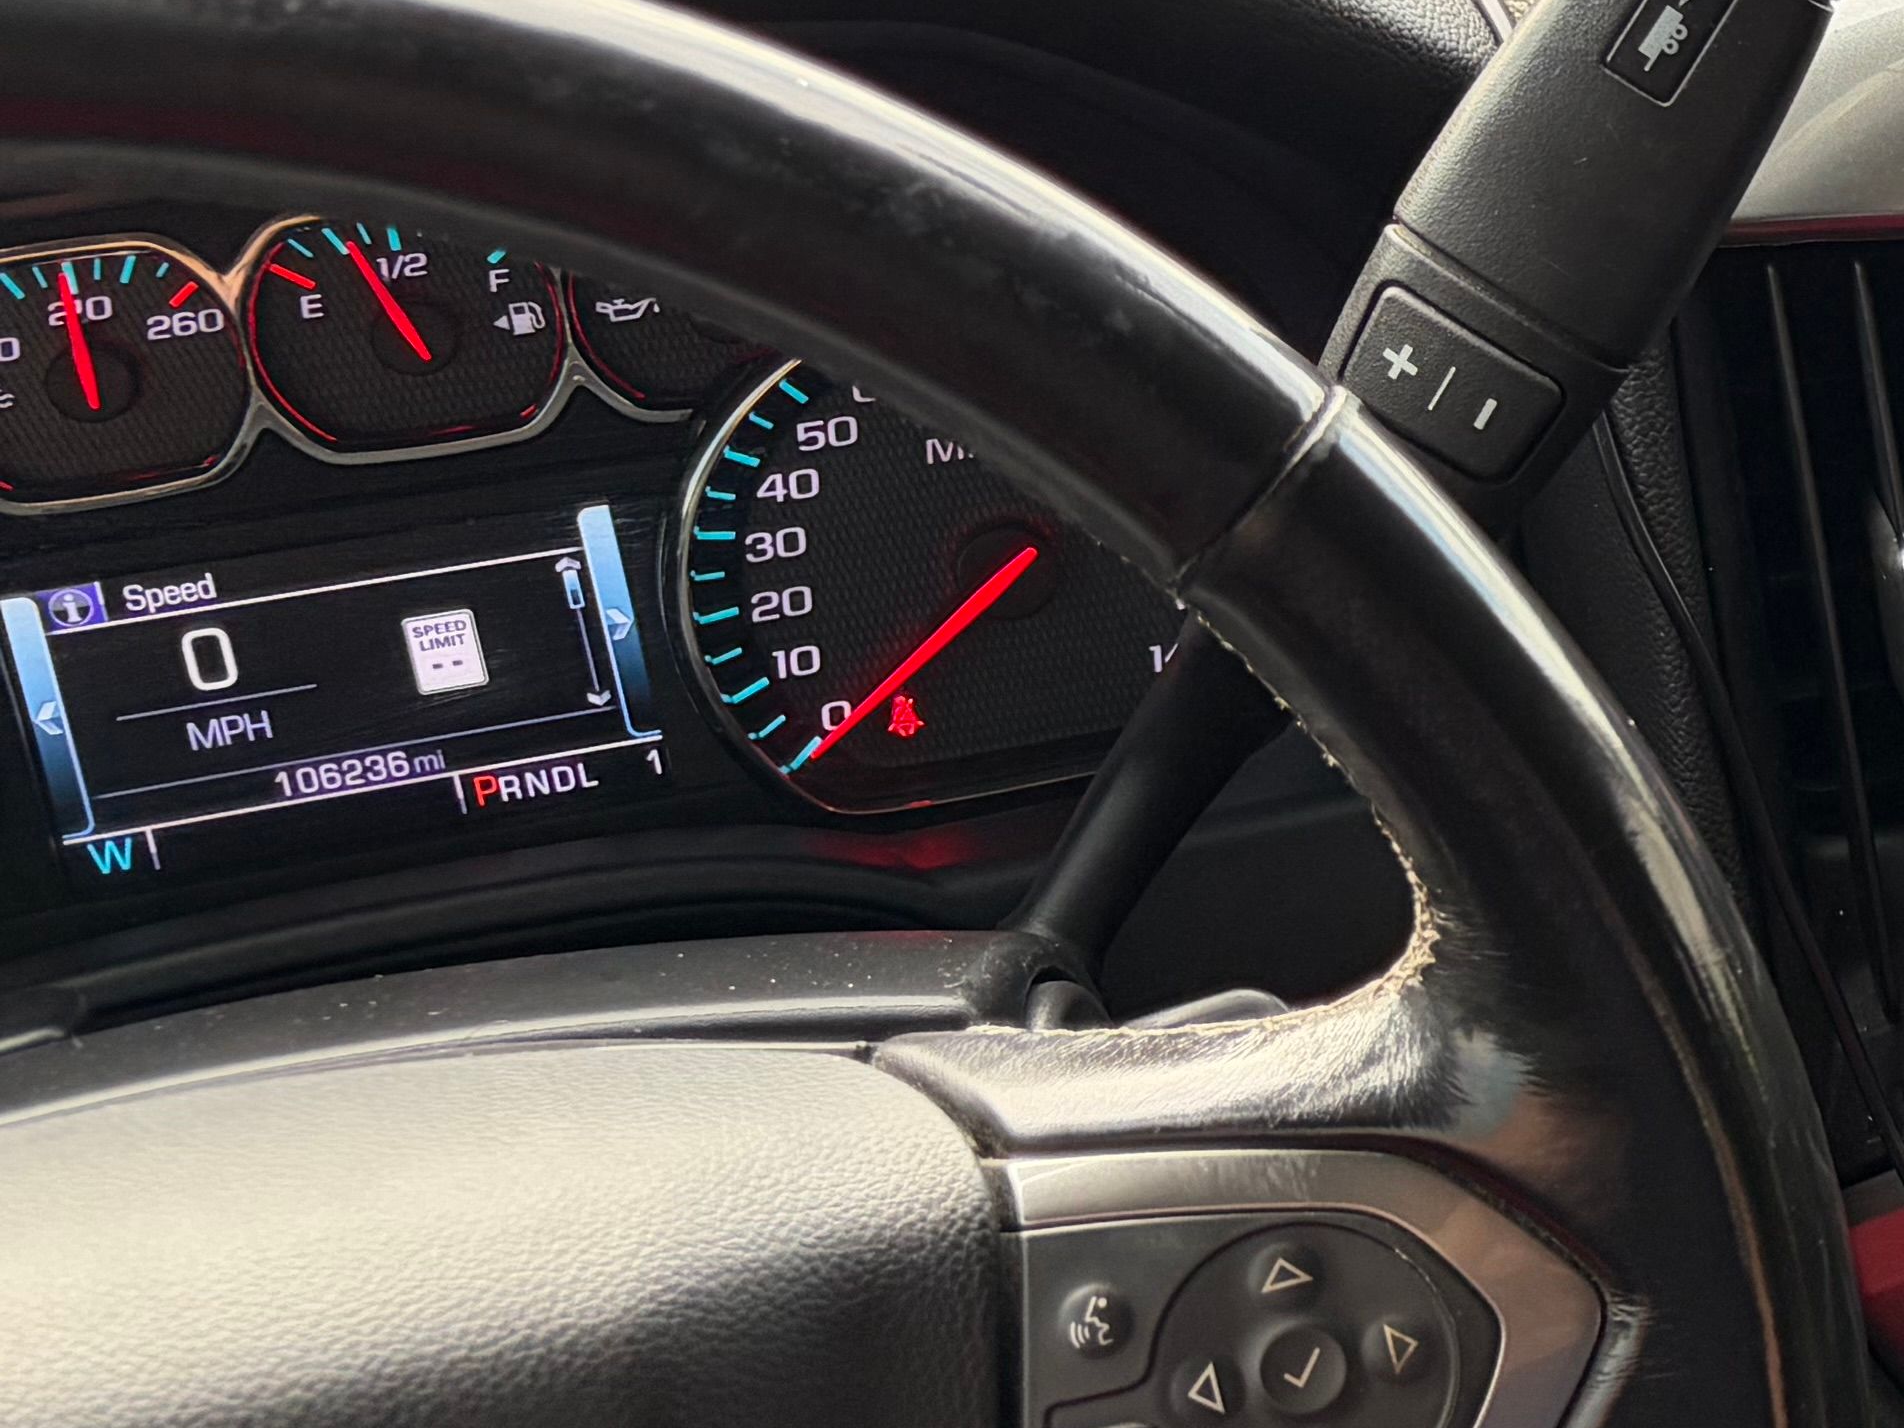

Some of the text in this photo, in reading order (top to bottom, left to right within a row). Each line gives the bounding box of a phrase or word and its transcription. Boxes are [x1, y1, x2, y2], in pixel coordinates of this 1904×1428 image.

[376, 253, 429, 279] 1/2
[488, 269, 510, 292] F
[300, 294, 324, 319] E
[147, 308, 224, 340] 260
[796, 415, 859, 452] 50
[756, 468, 820, 502] 40
[744, 526, 808, 564] 30
[123, 573, 217, 612] Speed
[750, 586, 813, 624] 20
[412, 620, 467, 639] SPEED
[419, 633, 465, 652] LIMIT
[180, 628, 238, 691] 0
[772, 645, 822, 679] 10
[186, 710, 274, 752] MPH
[820, 700, 852, 730] 0
[87, 838, 133, 875] W
